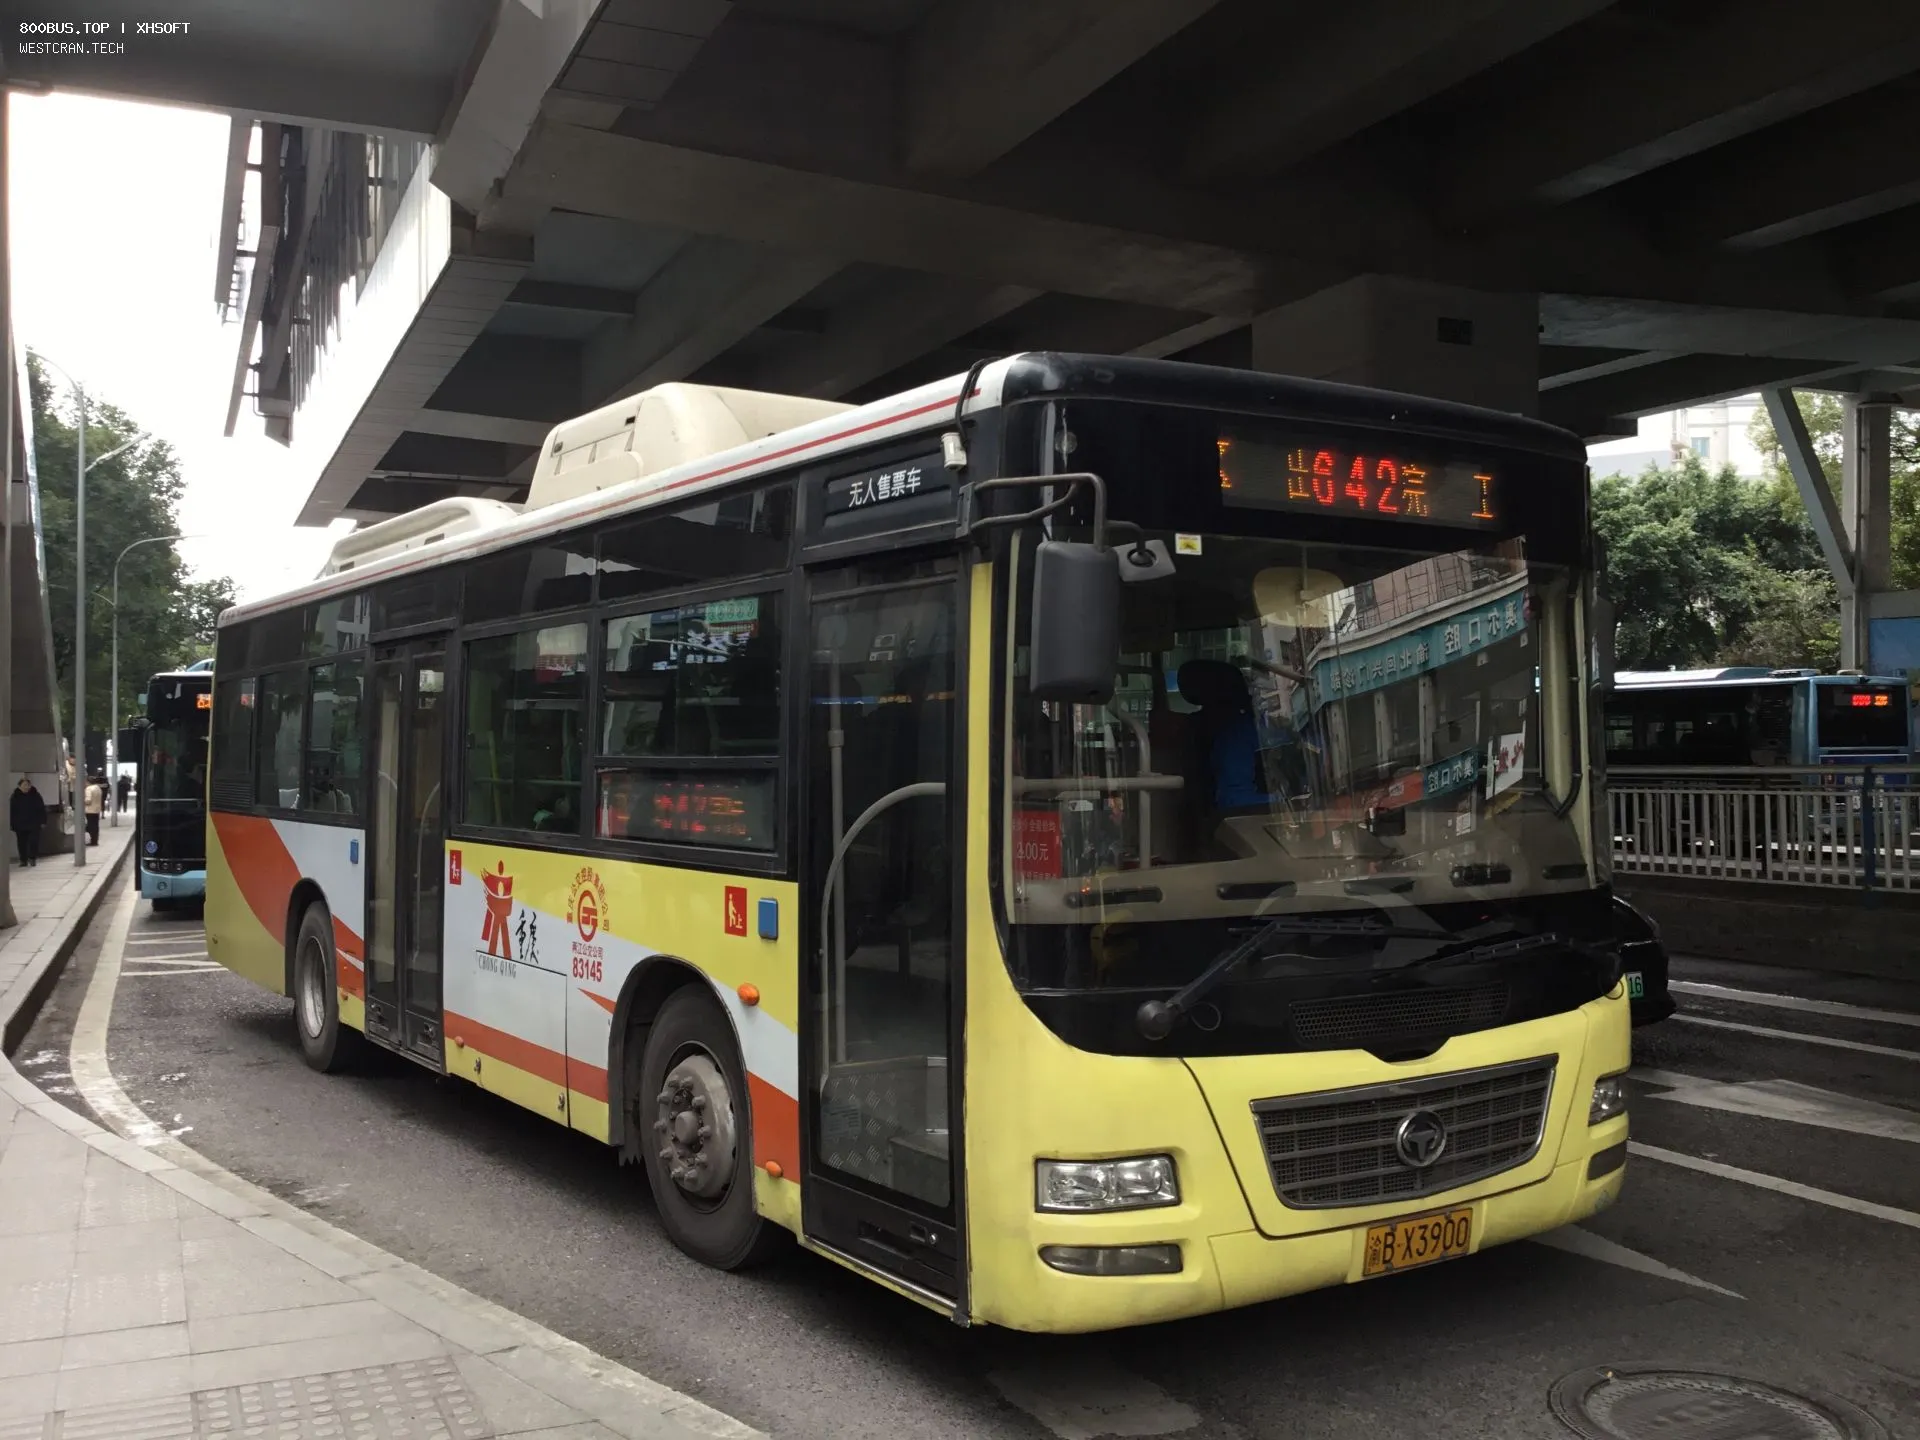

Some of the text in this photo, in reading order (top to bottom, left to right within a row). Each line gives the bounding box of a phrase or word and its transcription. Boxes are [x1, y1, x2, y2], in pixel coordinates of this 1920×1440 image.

[848, 467, 922, 508] 无人售票车
[1312, 451, 1398, 514] 642
[572, 957, 603, 982] 83145
